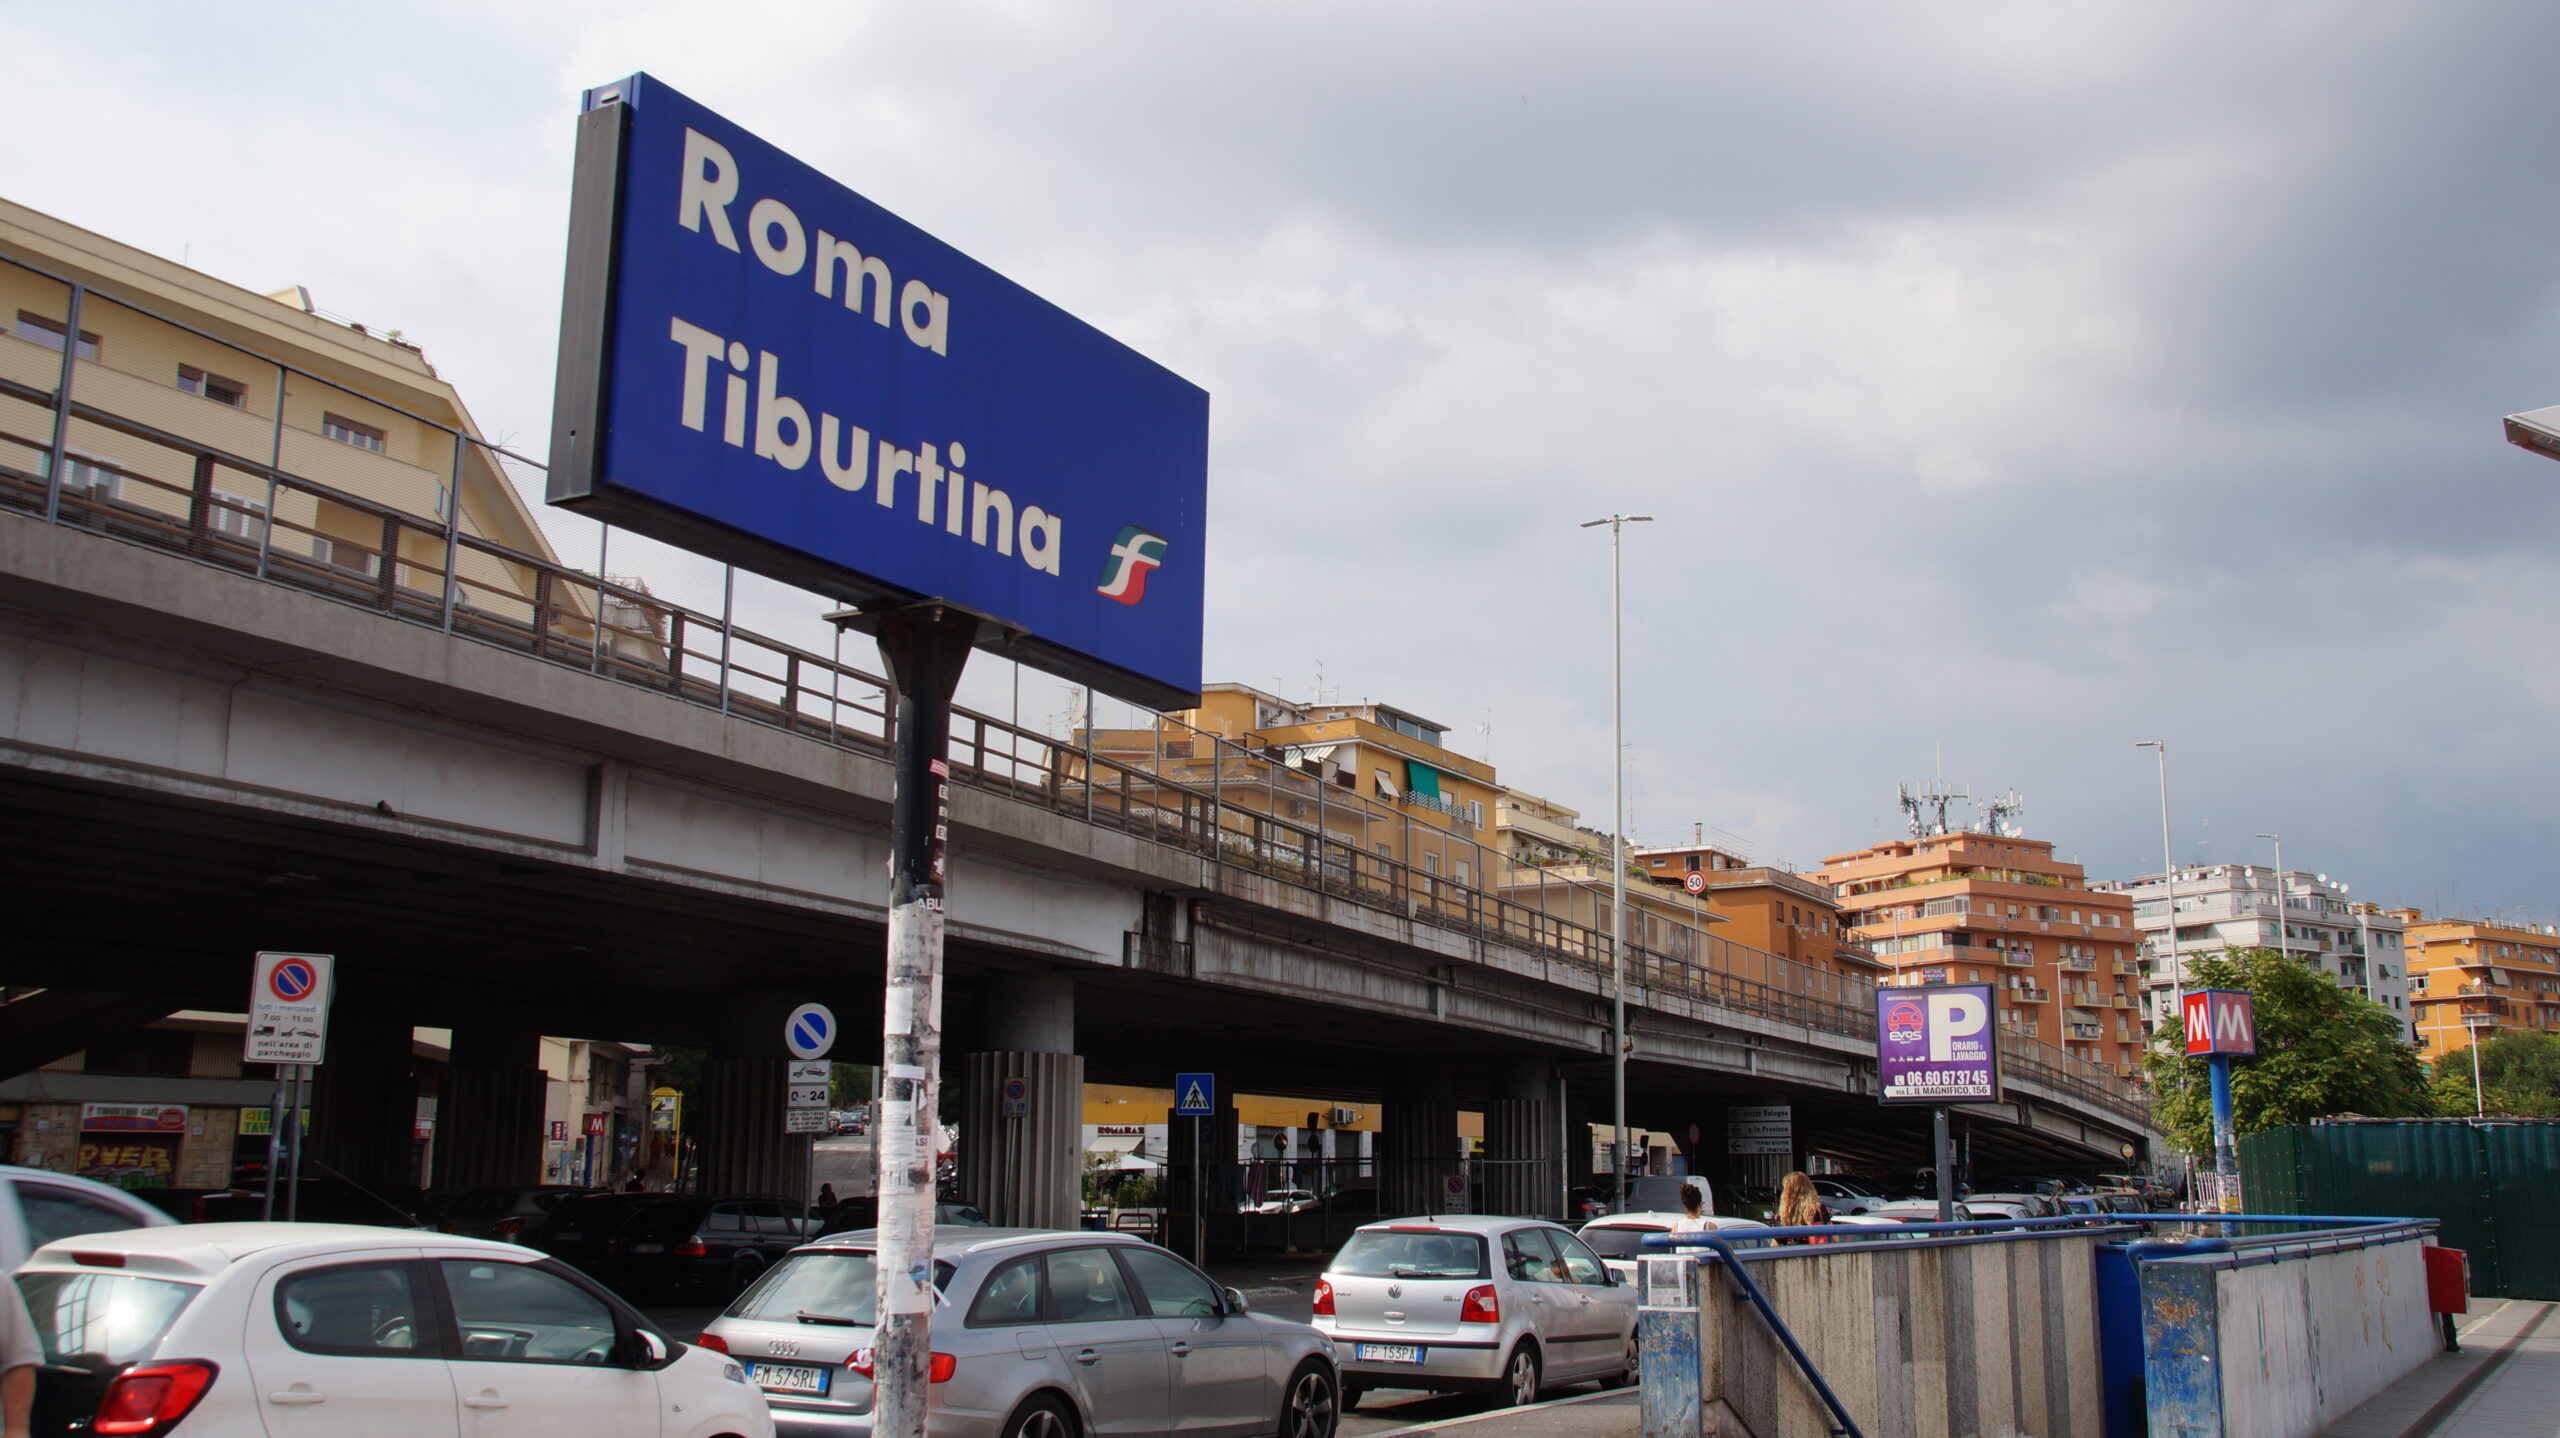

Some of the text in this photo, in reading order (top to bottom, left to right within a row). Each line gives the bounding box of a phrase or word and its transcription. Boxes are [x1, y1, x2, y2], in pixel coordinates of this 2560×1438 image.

[678, 126, 950, 358] Roma
[670, 316, 1062, 577] Tiburtina
[1689, 877, 1701, 887] 50
[263, 1013, 281, 1021] 7.00
[292, 1015, 314, 1023] 11.00
[2188, 1003, 2210, 1042] M
[2215, 1003, 2249, 1042] M
[1928, 993, 1987, 1062] P
[257, 1040, 300, 1049] nell'area
[1952, 1041, 1979, 1051] ORARIO
[257, 1050, 311, 1059] parcheggio
[1952, 1051, 1987, 1061] LAVAGGIO
[1906, 1070, 1988, 1086] 06.60 67 37 45
[791, 1090, 799, 1101] 0
[809, 1090, 825, 1101] 24
[1922, 1086, 1971, 1096] MAGNIFICO,
[1972, 1085, 1988, 1095] 156
[1763, 1109, 1788, 1118] Bologna
[591, 1117, 603, 1132] M
[1364, 1344, 1416, 1361] FP 153PA
[774, 1367, 817, 1389] 575RL
